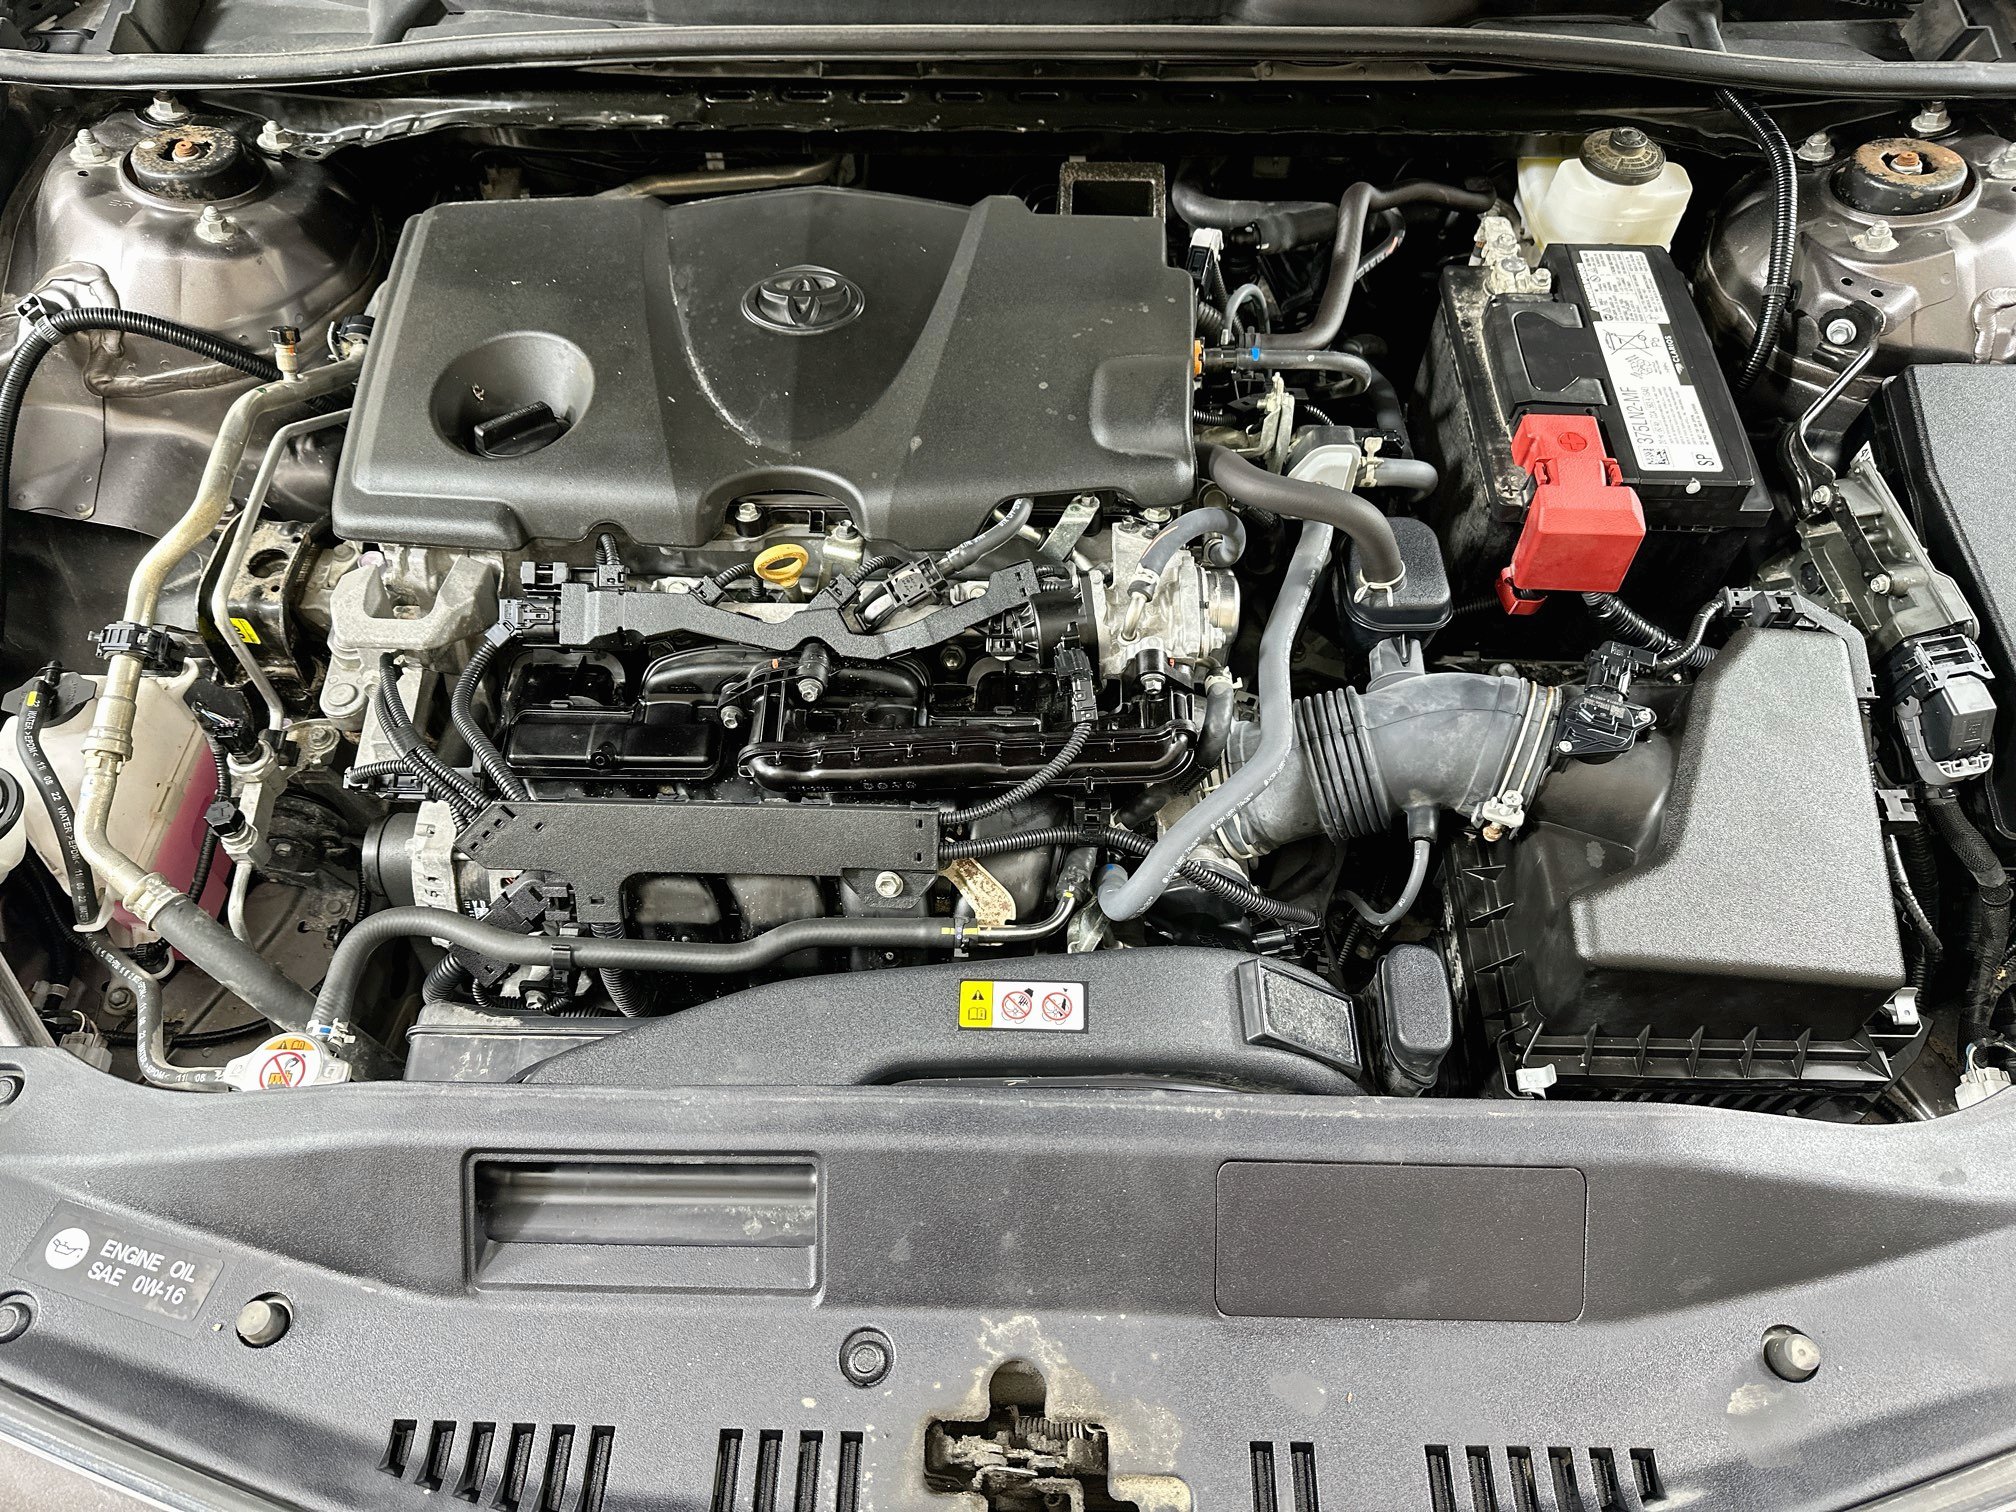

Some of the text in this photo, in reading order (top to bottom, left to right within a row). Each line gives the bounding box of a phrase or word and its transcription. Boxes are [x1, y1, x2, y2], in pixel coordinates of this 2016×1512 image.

[1664, 335, 1681, 365] CLARIOS
[1620, 386, 1655, 445] 375LN2-MF
[1697, 453, 1715, 467] SP
[24, 710, 38, 732] WATER
[51, 791, 62, 802] 22
[57, 805, 73, 833] WATER
[99, 1238, 197, 1283] ENGINE OIL
[87, 1261, 187, 1305] SAE 0W-16
